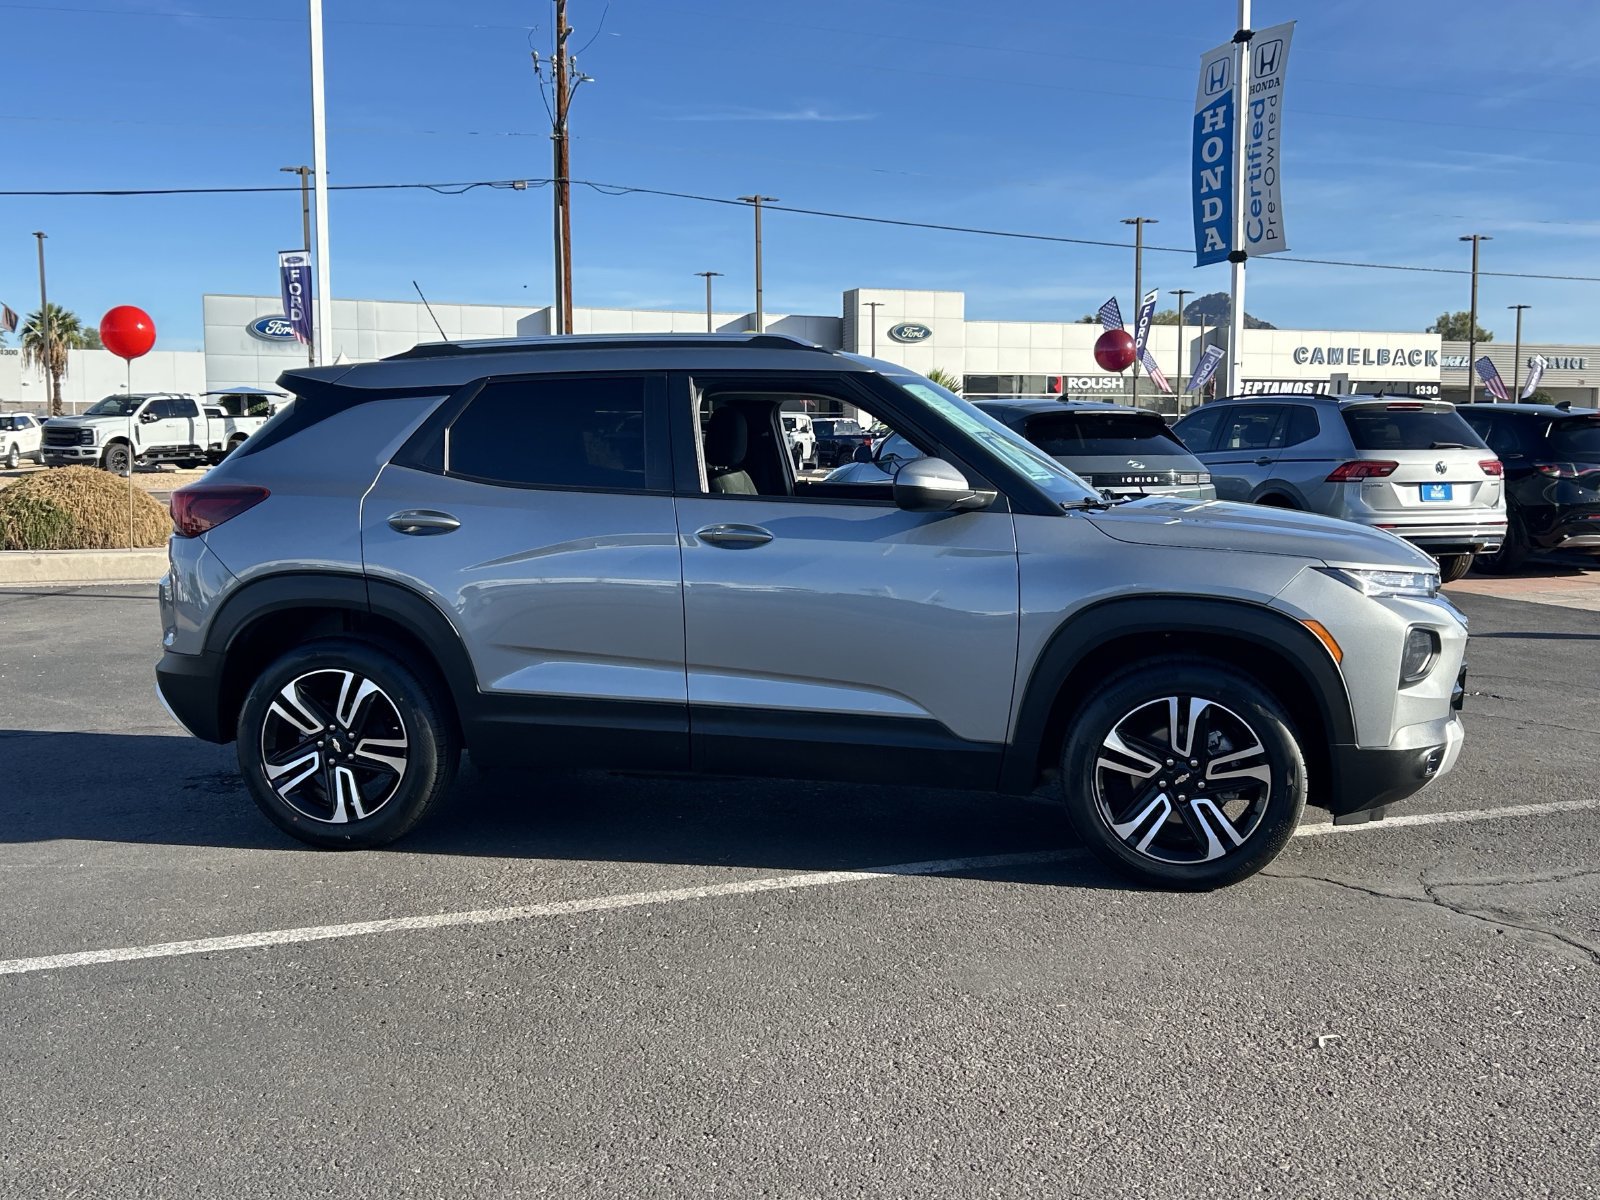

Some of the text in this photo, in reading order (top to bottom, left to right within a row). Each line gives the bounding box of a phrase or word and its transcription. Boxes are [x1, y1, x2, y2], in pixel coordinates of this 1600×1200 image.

[1250, 77, 1281, 95] HONDA
[1247, 98, 1265, 243] Certified
[1264, 94, 1278, 241] Pre-Owned
[1200, 105, 1227, 252] HONDA
[289, 269, 302, 321] FORD
[901, 326, 926, 338] Ford
[1136, 305, 1151, 348] FORD
[1293, 347, 1439, 366] CAMELBACK
[1527, 356, 1590, 369] SRVICE
[1068, 377, 1124, 389] ROUSH
[1415, 385, 1439, 395] 1330
